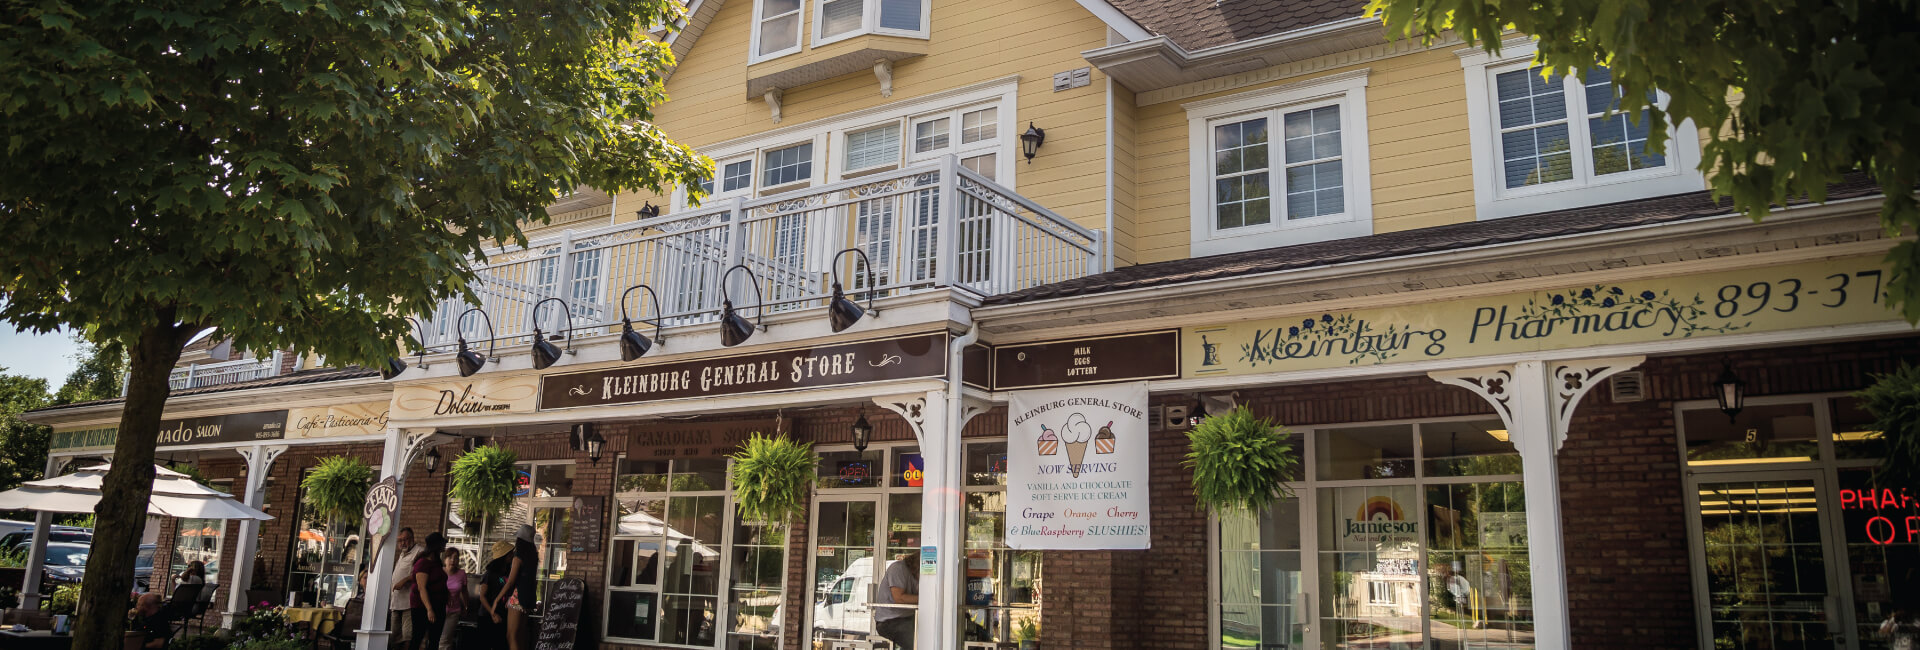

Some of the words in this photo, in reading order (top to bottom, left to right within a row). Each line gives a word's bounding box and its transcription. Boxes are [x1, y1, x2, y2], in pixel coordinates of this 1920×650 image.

[1249, 319, 1446, 362] Kleinburg
[1469, 304, 1681, 343] Pharmacy
[1714, 270, 1884, 318] 893-37
[1073, 347, 1091, 355] MILK
[1074, 357, 1091, 366] EGGS
[601, 371, 690, 400] KLEINBURG
[700, 361, 780, 391] GENERAL
[790, 352, 856, 383] STORE
[1067, 366, 1098, 376] LOTTERY
[433, 383, 485, 416] Dolcini
[1014, 399, 1066, 426] KLEINBURG
[1067, 397, 1111, 408] GENERAL
[1111, 401, 1144, 420] STORE
[196, 424, 221, 438] SALON
[1746, 430, 1757, 442] 5
[840, 467, 869, 479] OPEN
[1037, 463, 1065, 475] NOW
[1065, 462, 1118, 475] SERVING
[904, 469, 923, 482] OL
[1027, 482, 1059, 491] VANILLA
[1060, 481, 1078, 490] AND
[1079, 480, 1133, 490] CHOCOLATE
[363, 486, 398, 519] GELATO
[1032, 493, 1052, 501] SOFT
[1053, 493, 1079, 501] SERVE
[1081, 492, 1096, 500] ICE
[1097, 491, 1128, 500] CREAM
[1022, 507, 1055, 522] Grape
[1063, 507, 1098, 520] Orange
[1106, 505, 1139, 520] Cherry
[1010, 525, 1019, 536] &
[1020, 524, 1085, 538] BlueRaspberry
[1086, 525, 1149, 536] SLUSHIES!
[1343, 517, 1419, 537] Jamieson
